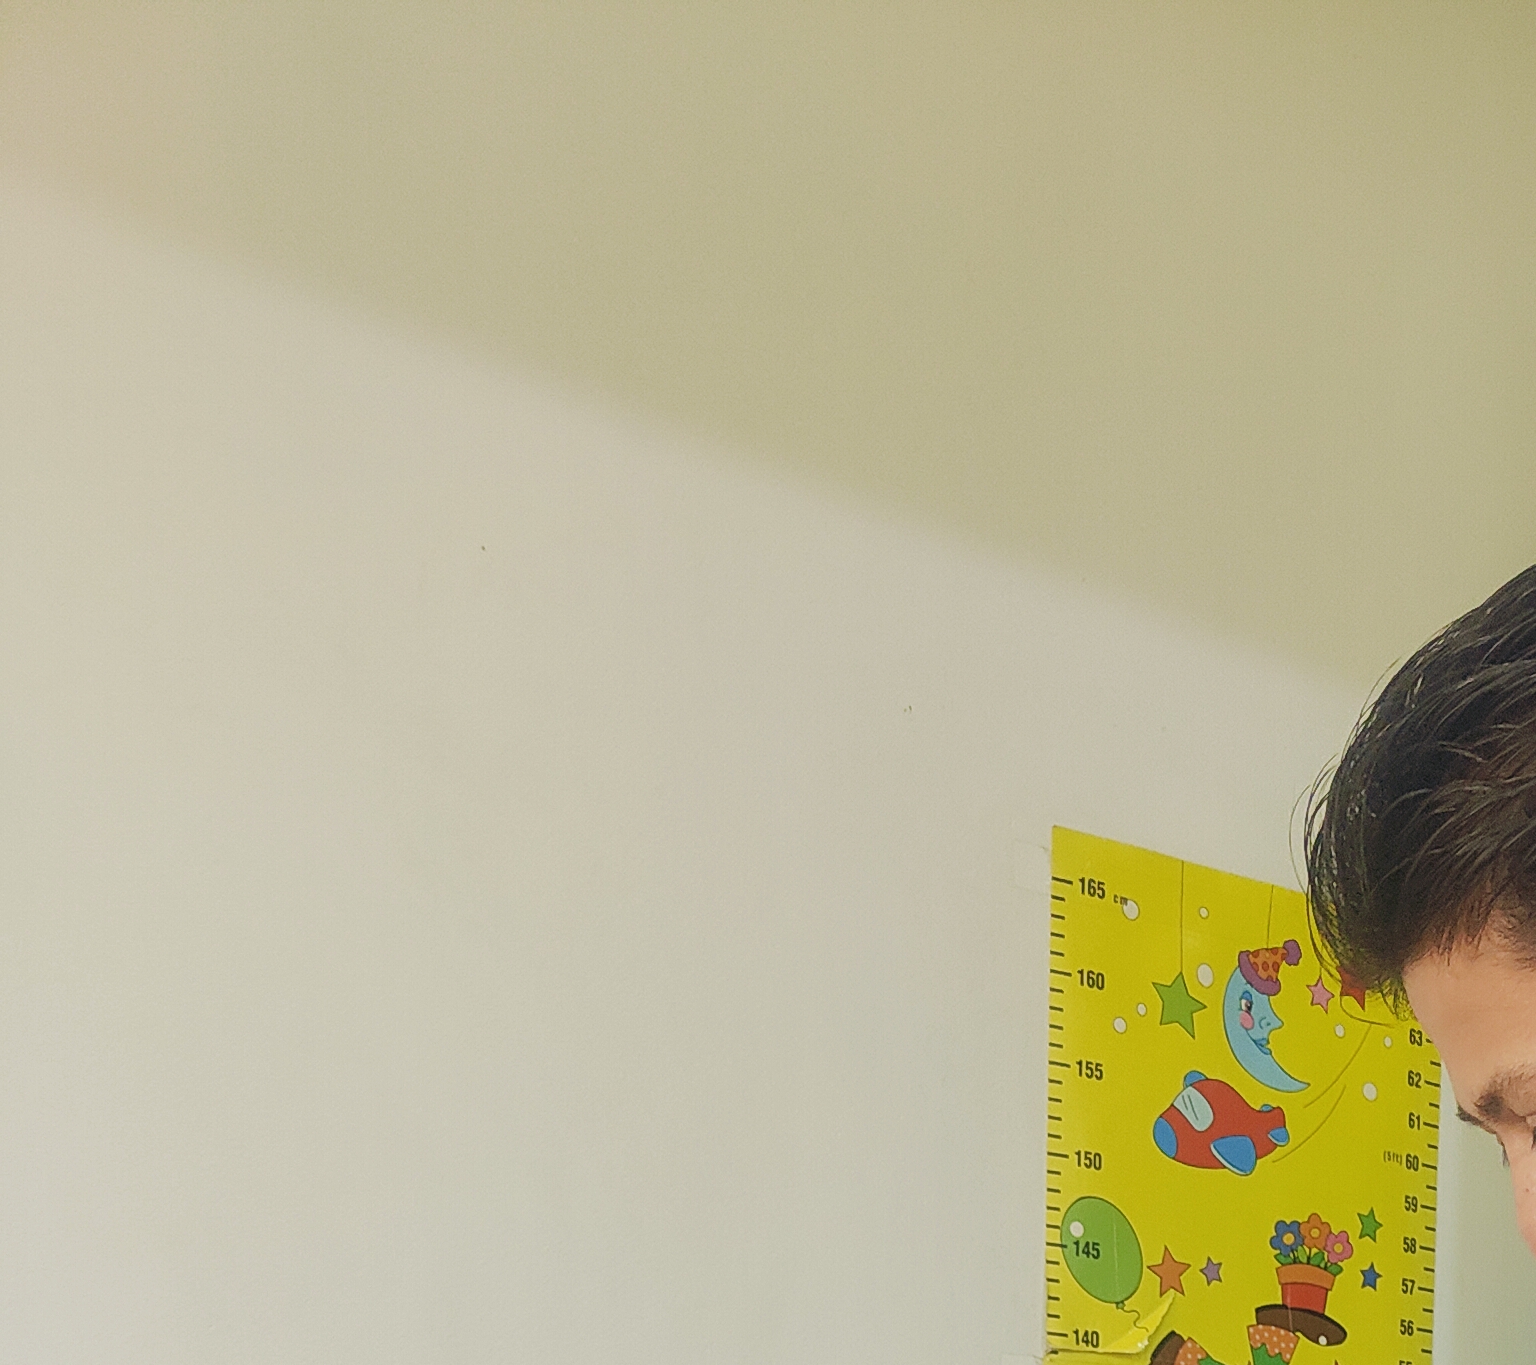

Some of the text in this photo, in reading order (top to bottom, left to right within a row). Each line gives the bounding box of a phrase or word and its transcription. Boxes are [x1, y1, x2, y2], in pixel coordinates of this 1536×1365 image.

[1079, 877, 1128, 906] 165 cm
[1077, 969, 1104, 990] 160
[1410, 1029, 1422, 1046] 63
[1076, 1060, 1103, 1080] 155
[1408, 1070, 1421, 1088] 62
[1409, 1112, 1420, 1130] 61
[1075, 1150, 1101, 1170] 150
[1406, 1154, 1419, 1171] 60
[1405, 1195, 1417, 1213] 59
[1074, 1240, 1100, 1259] 145
[1403, 1237, 1416, 1254] 58
[1402, 1278, 1415, 1295] 57
[1400, 1319, 1414, 1336] 56
[1073, 1329, 1099, 1348] 140
